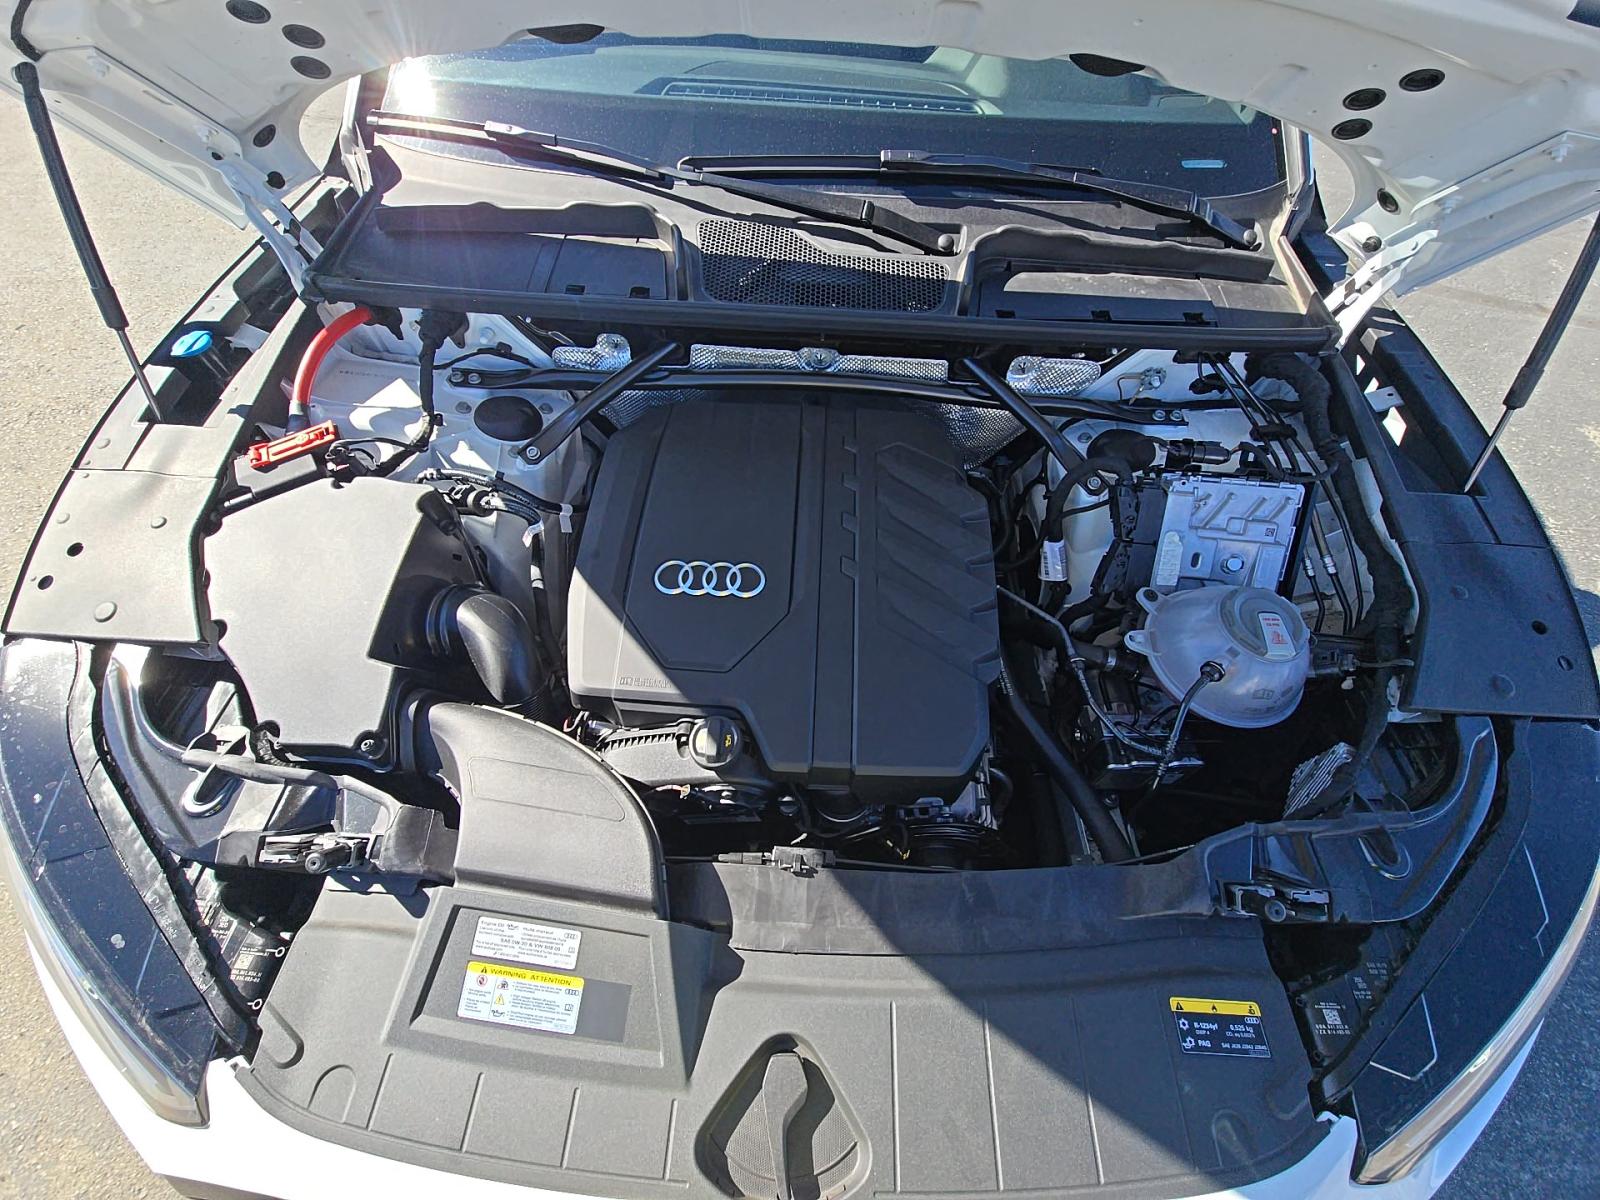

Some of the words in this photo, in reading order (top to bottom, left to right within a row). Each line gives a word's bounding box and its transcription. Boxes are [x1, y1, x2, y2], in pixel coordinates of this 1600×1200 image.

[490, 968, 526, 979] WARNING
[530, 975, 572, 986] ATTENTION
[1197, 1039, 1212, 1047] PAG
